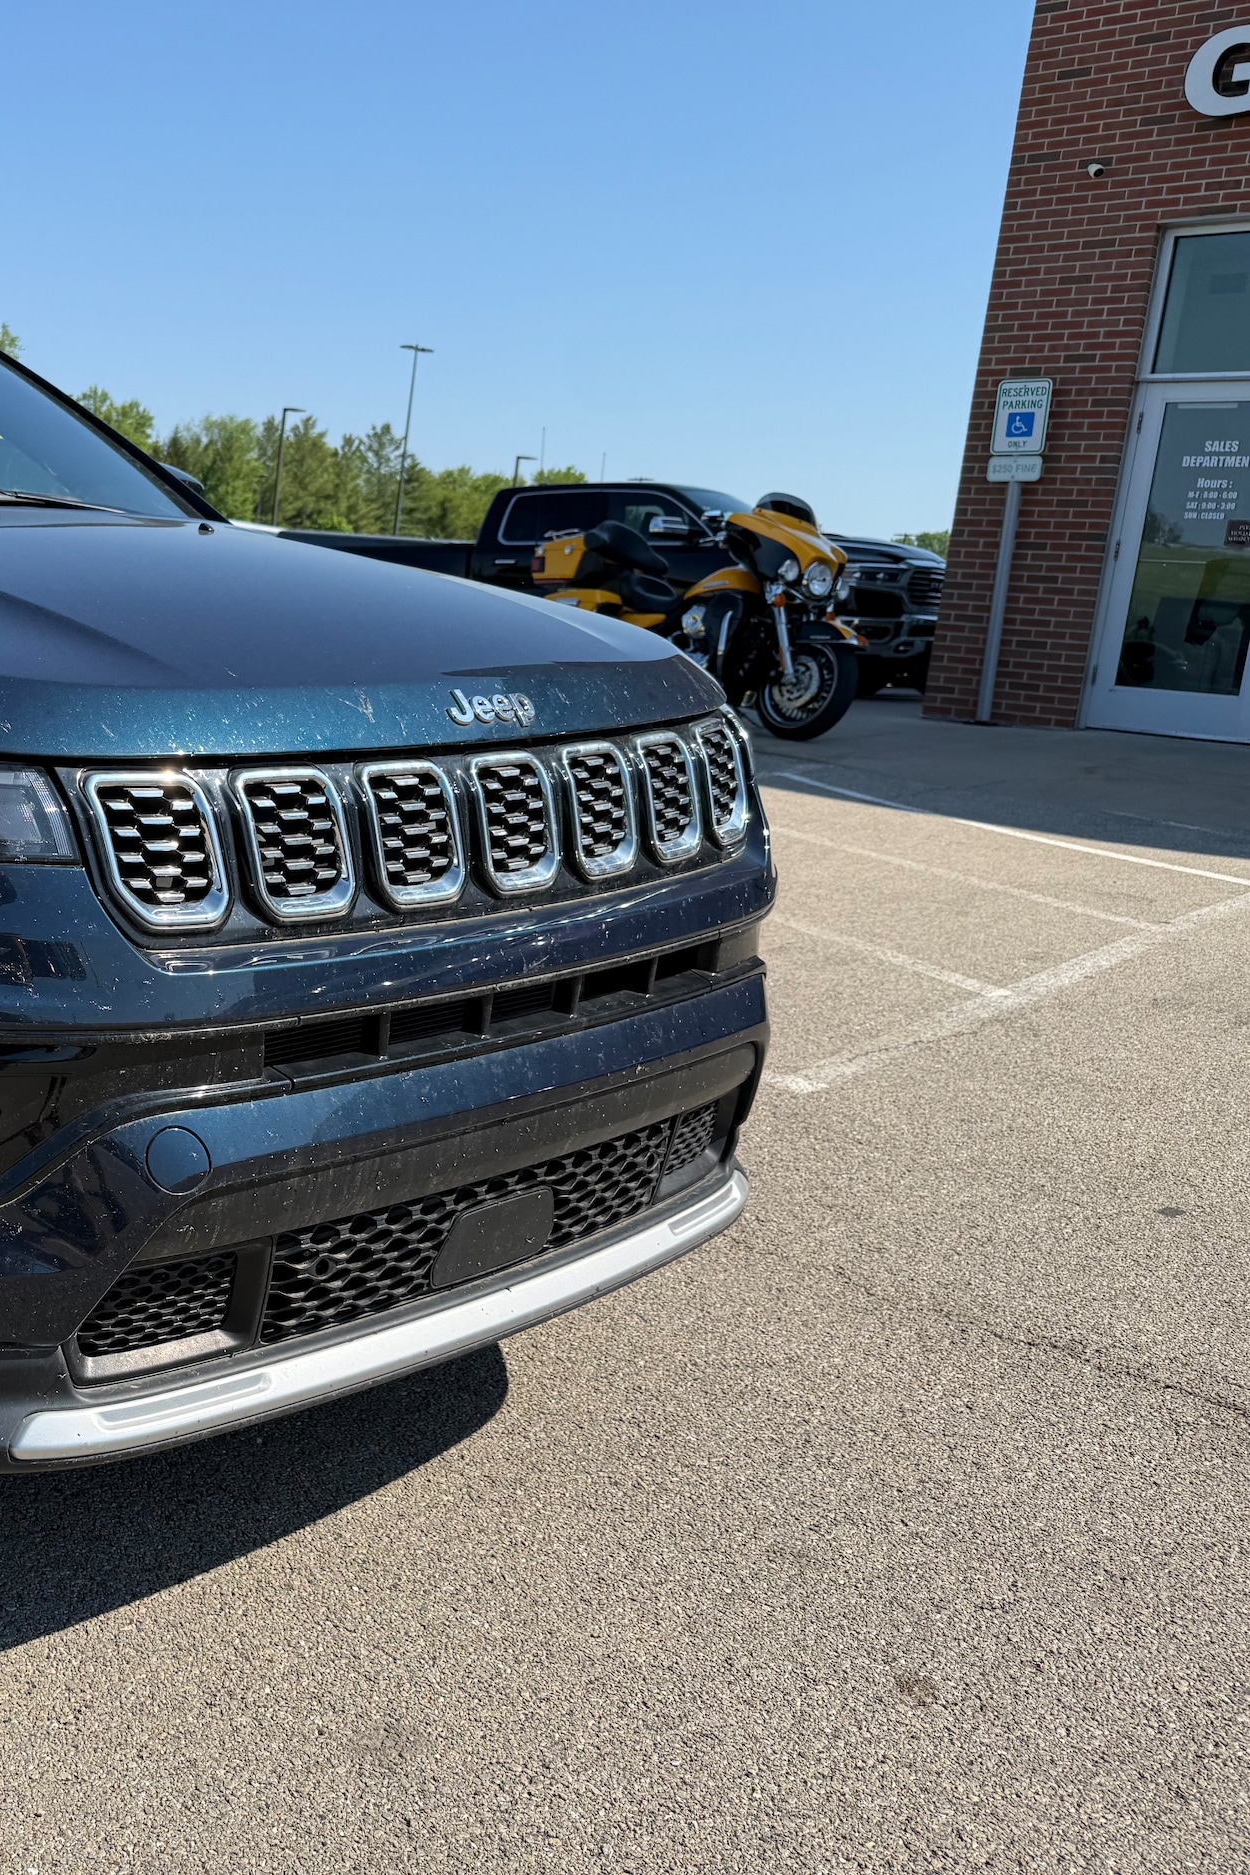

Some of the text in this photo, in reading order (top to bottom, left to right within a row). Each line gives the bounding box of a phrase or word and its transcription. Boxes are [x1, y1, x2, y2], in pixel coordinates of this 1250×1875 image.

[1001, 386, 1048, 398] RESERVED
[1002, 399, 1043, 410] PARKING
[1007, 440, 1028, 449] ONLY
[1204, 440, 1240, 453] SALES
[991, 463, 1038, 474] $250 FINE
[445, 688, 536, 728] Jeep
